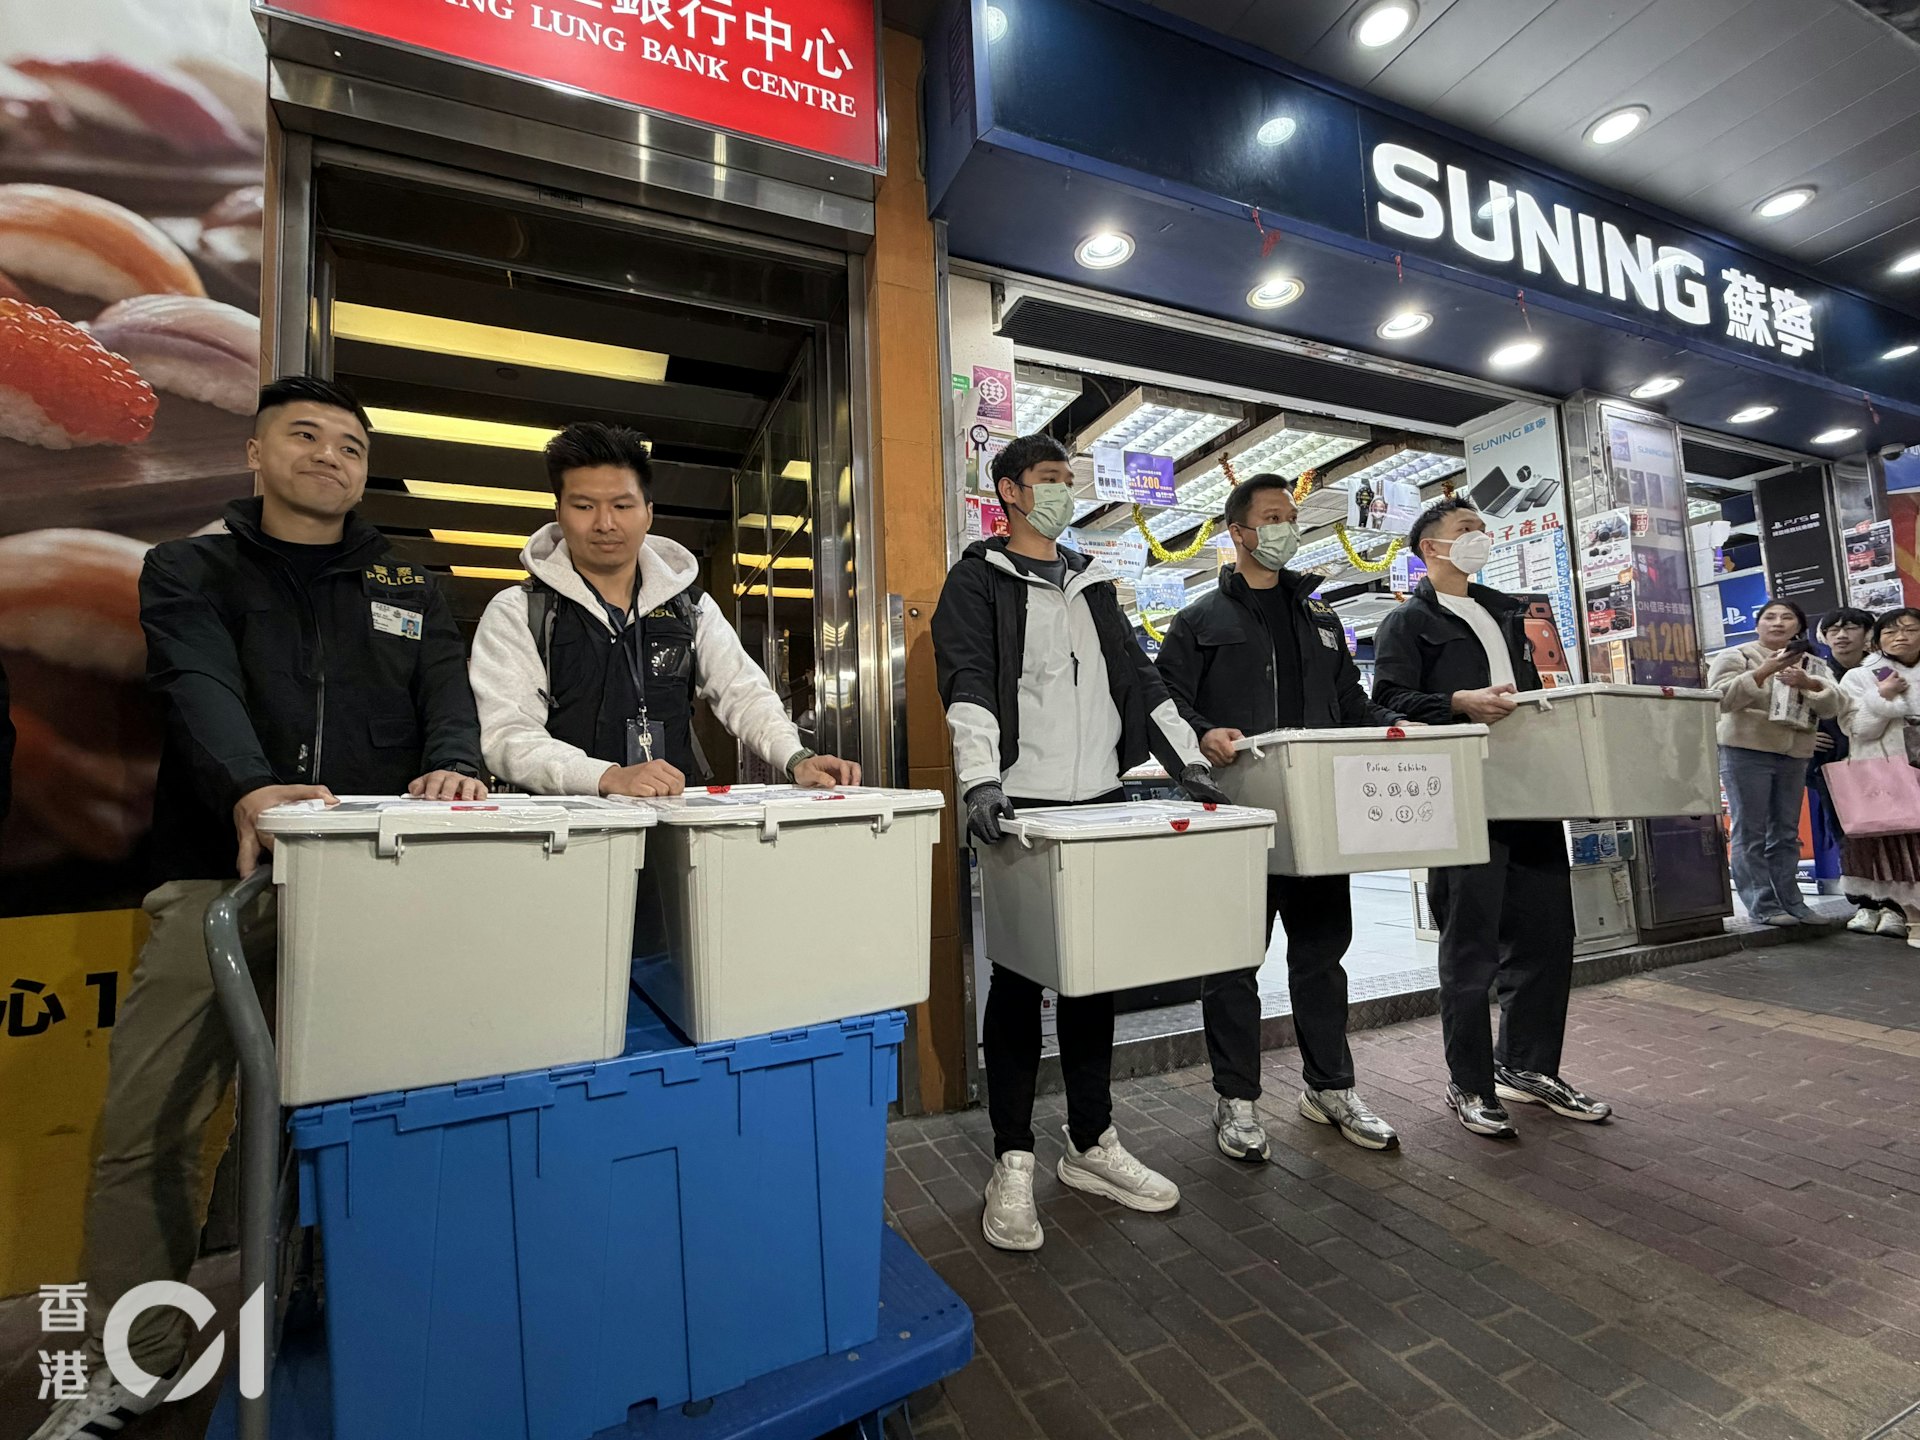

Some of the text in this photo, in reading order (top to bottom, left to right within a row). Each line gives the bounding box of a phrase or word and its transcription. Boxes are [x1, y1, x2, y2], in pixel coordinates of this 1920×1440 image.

[530, 4, 627, 52] LUNG
[641, 36, 729, 82] BANK
[741, 67, 856, 118] CENTRE
[574, 0, 854, 79] 銀行中心
[1372, 142, 1815, 357] SUNING 蘇寧
[1472, 427, 1522, 454] SUNING
[366, 570, 426, 586] POLICE
[1366, 762, 1390, 772] Police
[0, 978, 67, 1037] 心
